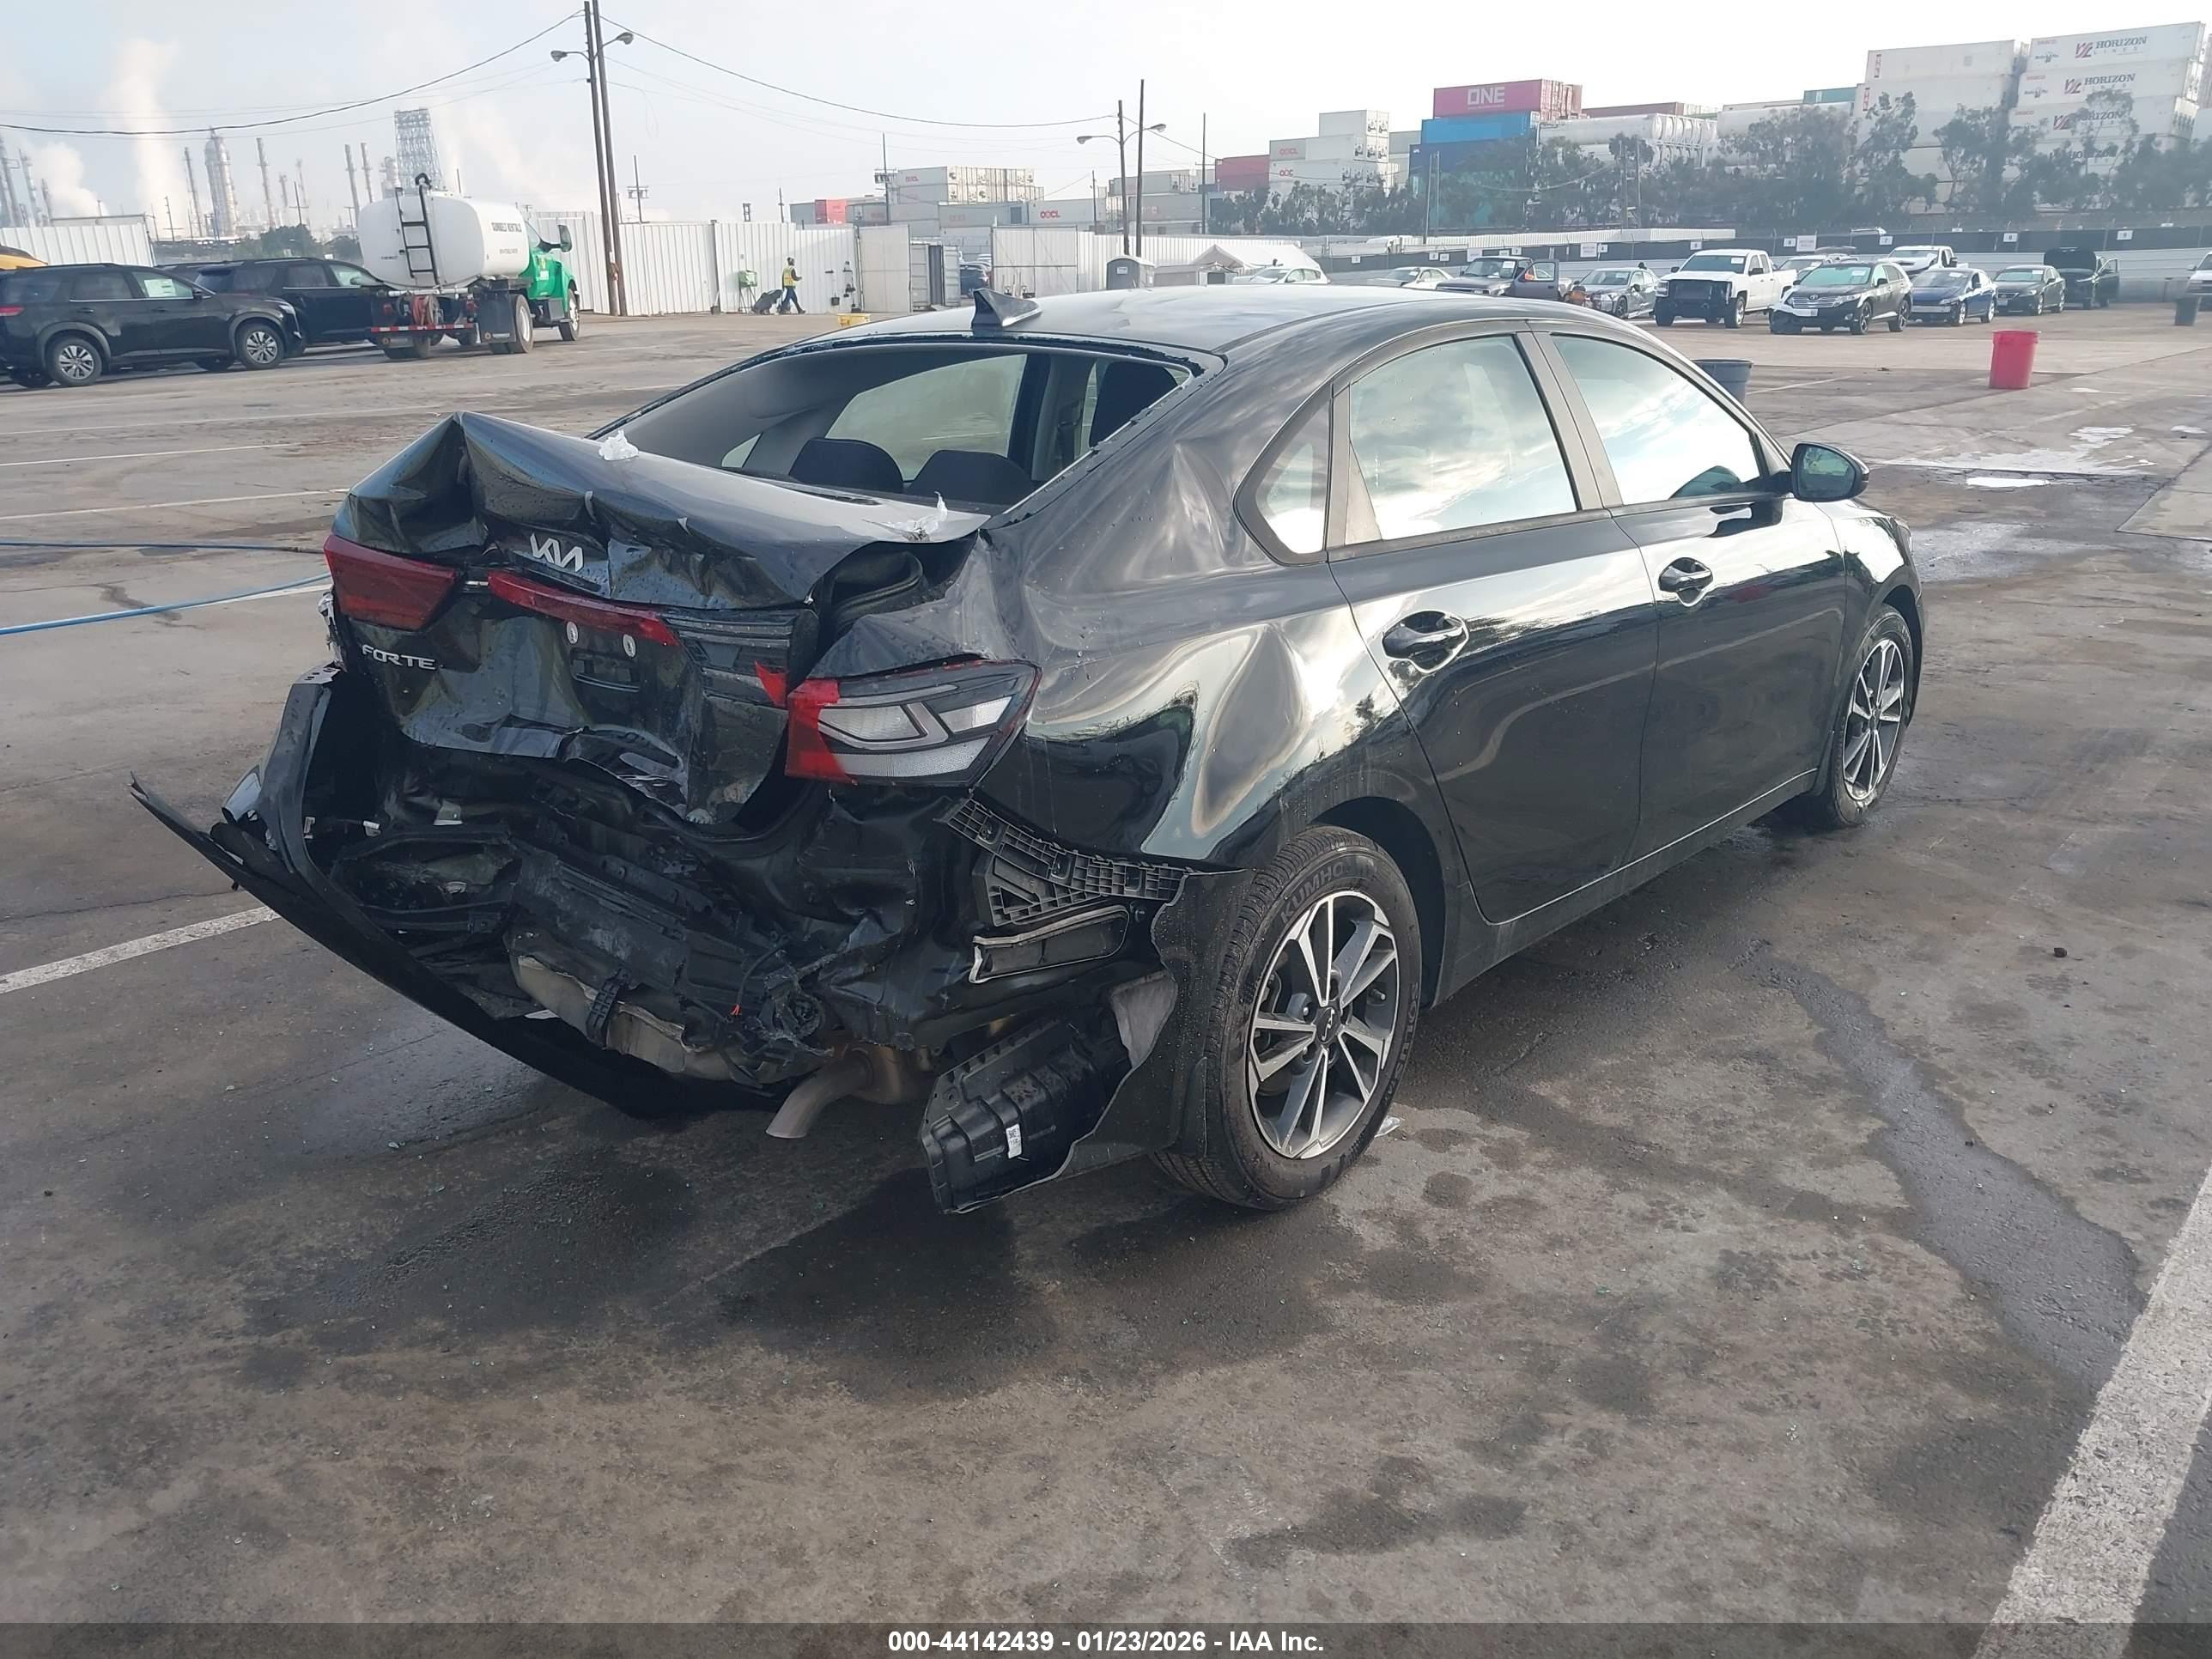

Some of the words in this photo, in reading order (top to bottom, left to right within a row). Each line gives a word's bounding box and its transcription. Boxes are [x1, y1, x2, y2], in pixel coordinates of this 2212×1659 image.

[2095, 36, 2148, 49] HORIZON
[2084, 73, 2136, 86] HORIZON
[1467, 87, 1505, 105] ONE
[530, 533, 584, 572] KIA
[362, 644, 437, 671] FORTE
[1279, 861, 1345, 925] KUMHO
